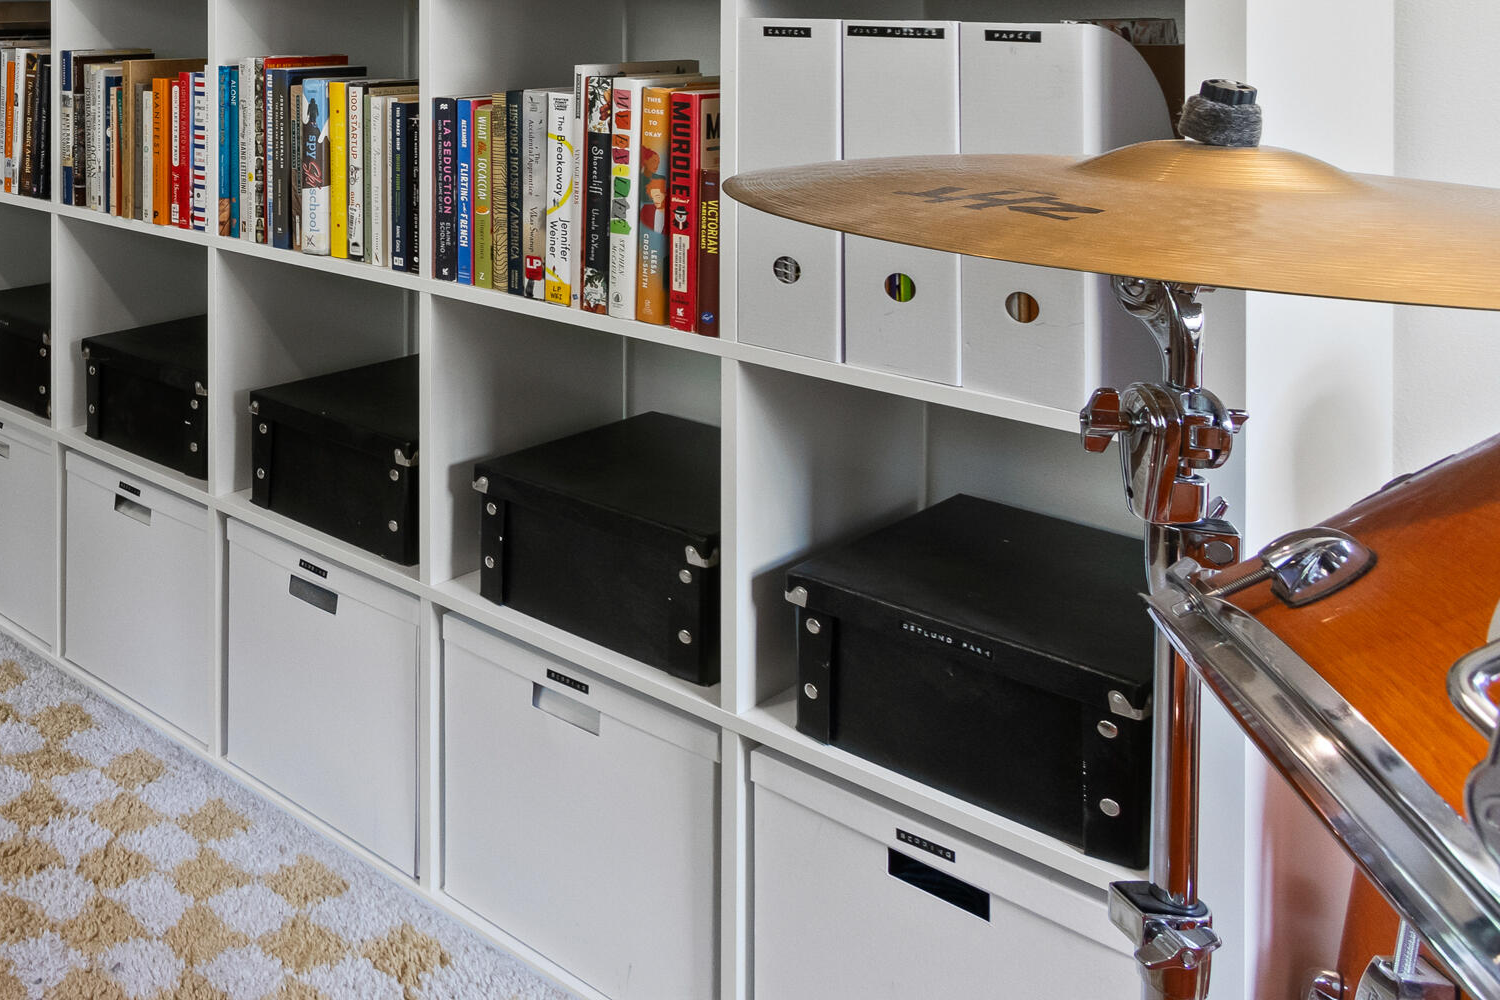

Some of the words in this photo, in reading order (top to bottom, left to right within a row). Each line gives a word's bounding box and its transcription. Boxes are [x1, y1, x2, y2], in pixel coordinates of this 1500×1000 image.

[443, 120, 452, 137] LA
[477, 116, 487, 139] WHAT
[509, 104, 519, 154] HISTORIC
[557, 115, 565, 131] The
[615, 95, 630, 125] MY
[306, 135, 318, 159] spy
[554, 135, 566, 196] Breakaway
[672, 101, 691, 198] MURDLE
[302, 161, 322, 188] Ski
[443, 140, 452, 214] SEDUCTION
[460, 163, 468, 201] FLIRTING
[477, 157, 488, 200] FOCACCIA!
[510, 157, 519, 198] HOUSES
[589, 146, 604, 195] Shorecliff
[613, 138, 630, 229] EX-LIFE
[309, 189, 320, 232] school
[510, 201, 520, 212] of
[529, 206, 537, 226] Vikas
[591, 208, 599, 231] Ursula
[460, 213, 468, 247] FRENCH
[510, 212, 520, 259] AMERICA
[528, 228, 538, 252] Swarup
[549, 220, 558, 258] Weiner
[558, 217, 570, 262] Jennifer
[707, 199, 718, 254] VICTORIAN
[590, 233, 599, 261] DeYoung
[642, 233, 650, 289] CROSS-SMITH
[650, 249, 658, 275] LEESA
